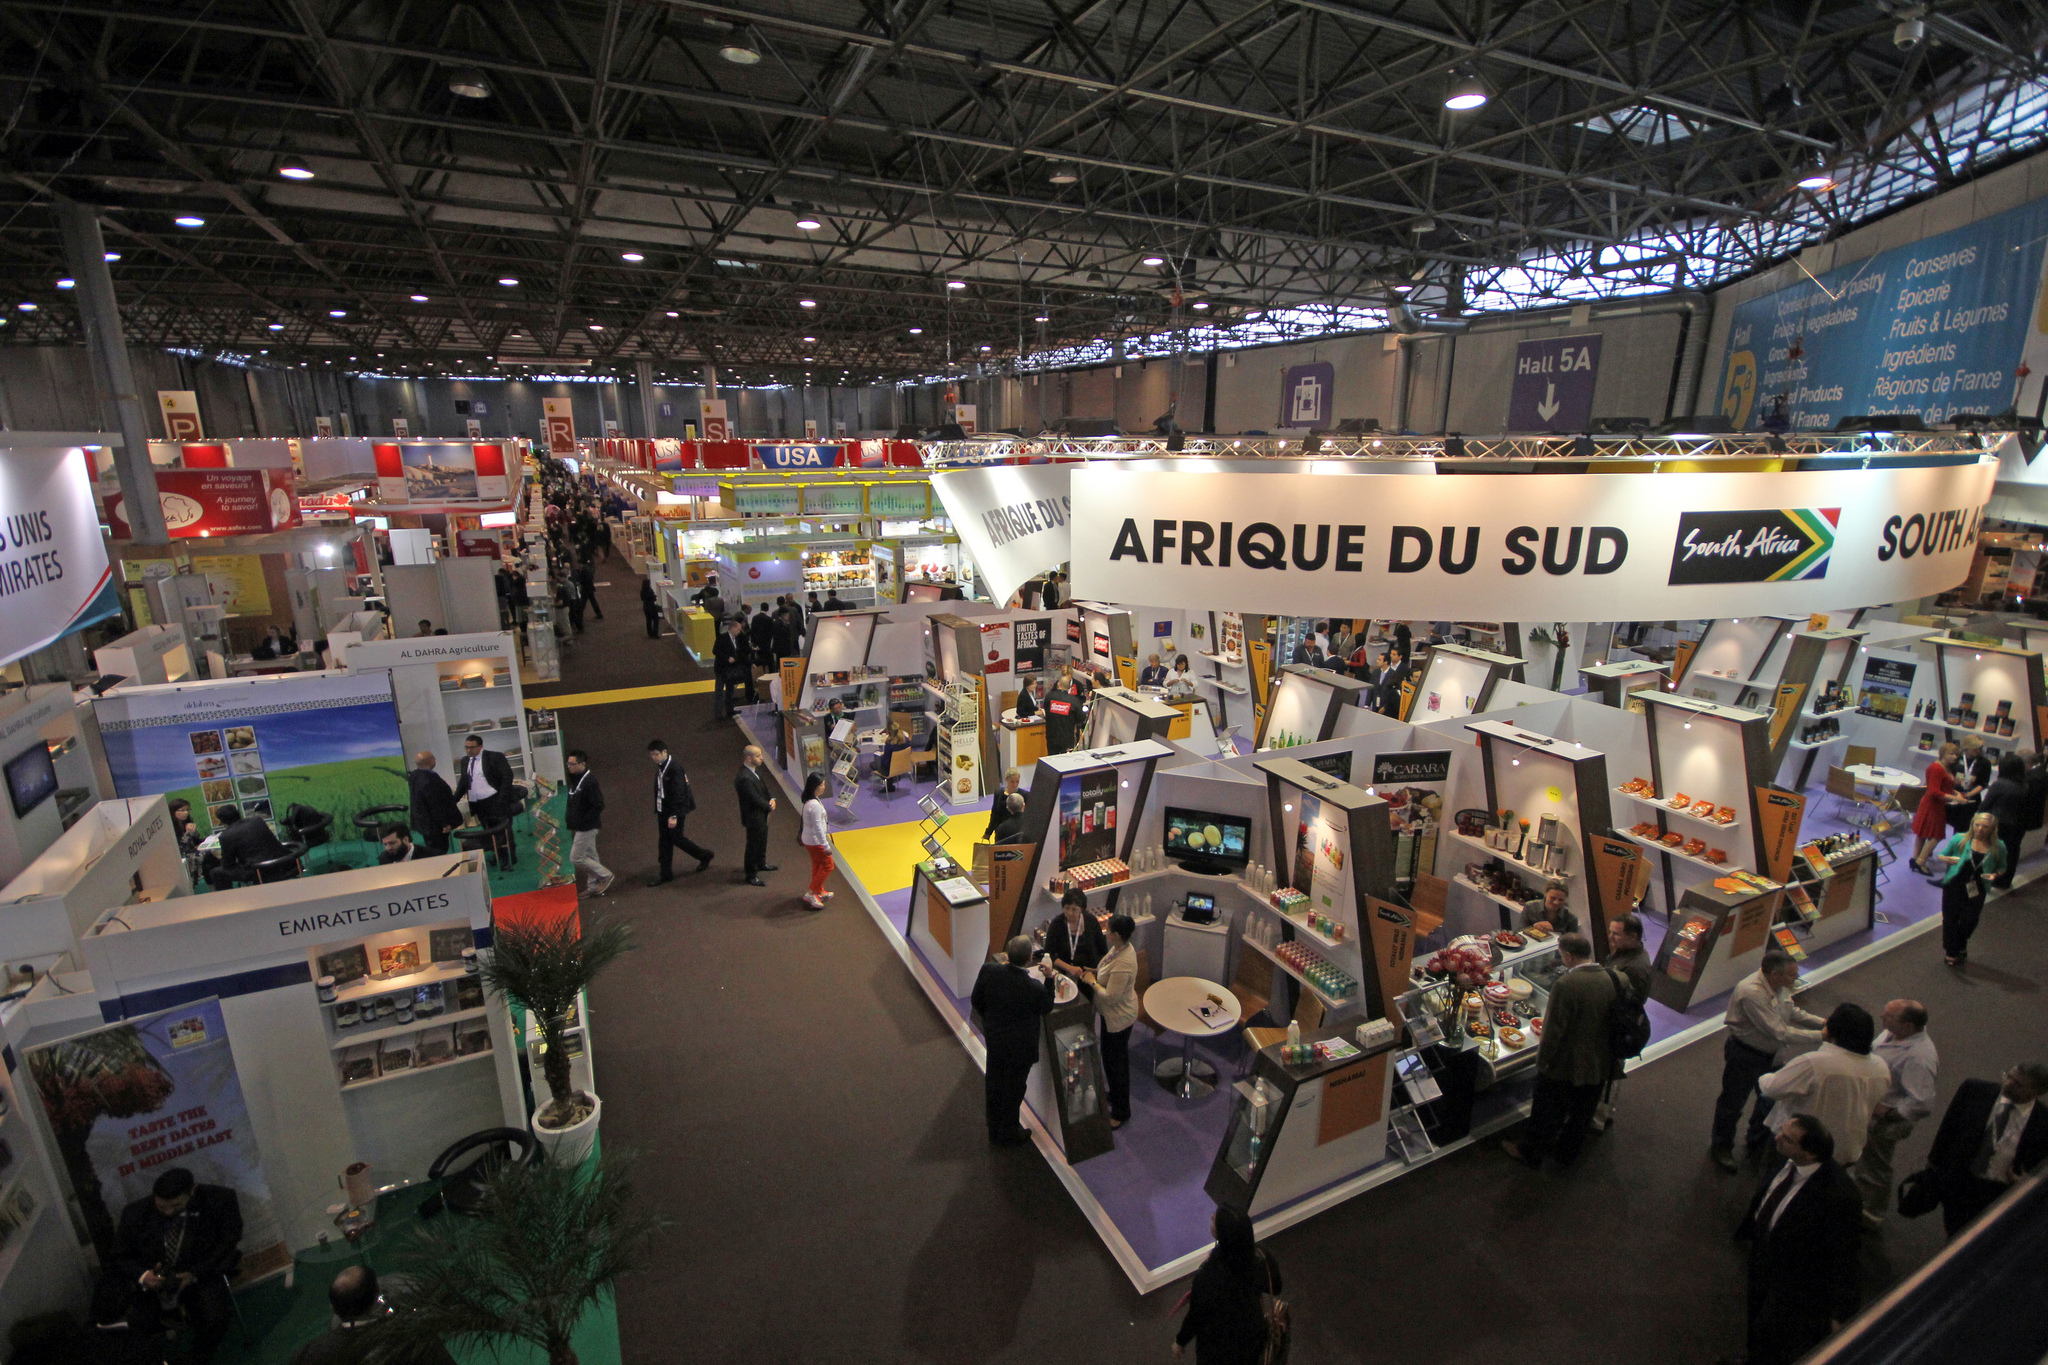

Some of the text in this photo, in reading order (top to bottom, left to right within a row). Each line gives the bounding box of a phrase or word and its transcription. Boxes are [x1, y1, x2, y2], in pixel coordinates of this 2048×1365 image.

[1906, 246, 1976, 280] Conserves
[1849, 273, 1886, 299] pastry
[1897, 281, 1951, 311] Epicerie
[1806, 305, 1858, 334] vegetables
[1889, 302, 2009, 340] Fruits & Légumes
[1733, 323, 1752, 347] Hall
[1518, 346, 1591, 375] Hall 5A
[1881, 341, 1956, 372] Ingrédients
[1799, 384, 1843, 403] Products
[1874, 369, 2002, 401] Régions de France
[1798, 411, 1830, 427] France
[1924, 402, 1942, 424] de
[172, 419, 195, 440] P
[551, 422, 571, 442] R
[708, 423, 723, 442] S
[655, 444, 681, 459] USA
[775, 447, 822, 466] USA
[861, 446, 883, 458] USA
[7, 510, 52, 548] UNIS
[981, 501, 1042, 549] AFRIQUE
[1035, 498, 1064, 529] DU
[1878, 506, 1980, 562] SOUTH A
[1109, 517, 1629, 576] AFRIQUE DU SUD
[1682, 526, 1800, 562] South Africa
[1016, 622, 1036, 632] UNITED
[1017, 630, 1046, 640] TASTES OF
[401, 644, 500, 658] AL DAHRA Agriculture
[1017, 640, 1038, 649] AFRICA.
[1393, 763, 1445, 774] CARARA
[128, 815, 164, 860] ROYAL DATES
[279, 893, 449, 936] EMIRATES DATES
[1330, 1070, 1366, 1088] NISHAMAI
[128, 1105, 207, 1139] TASTE THE
[129, 1119, 216, 1157] BEST DATES
[118, 1128, 232, 1177] IN MIDDLE EAST
